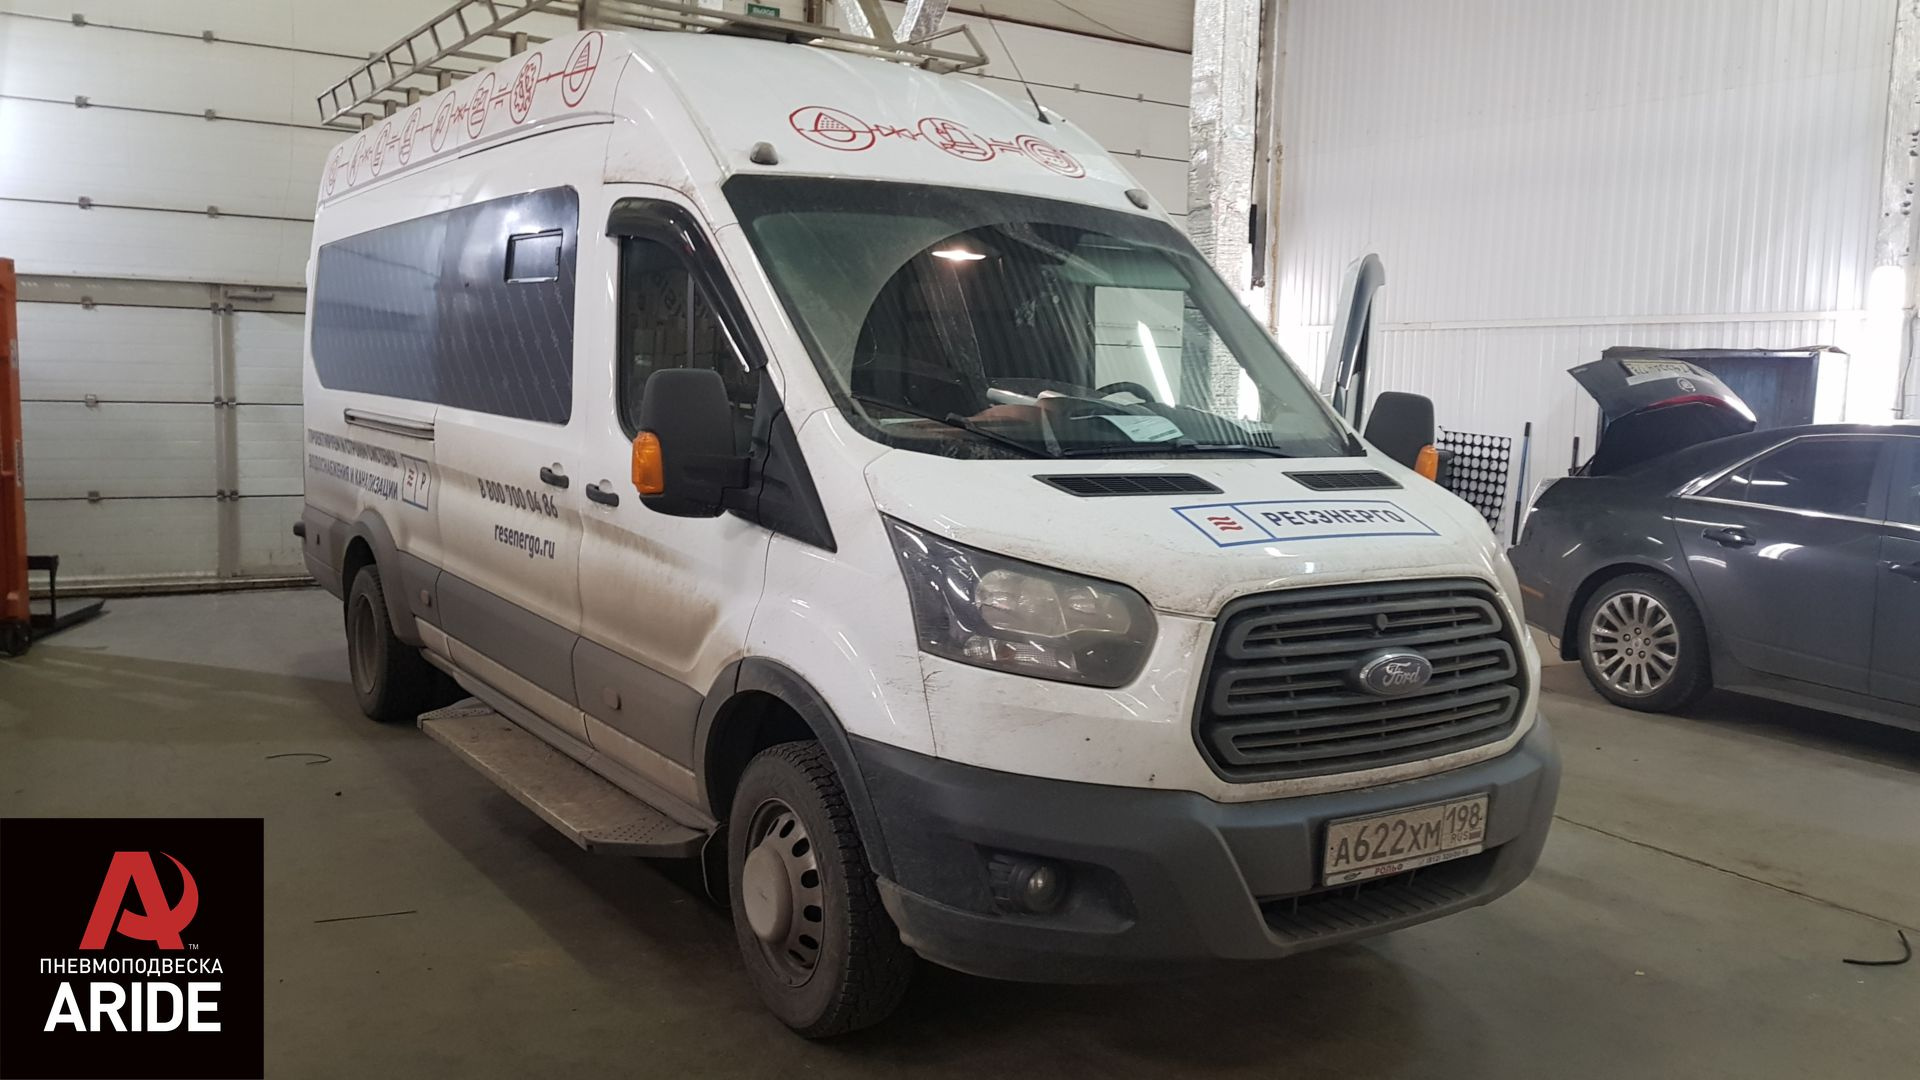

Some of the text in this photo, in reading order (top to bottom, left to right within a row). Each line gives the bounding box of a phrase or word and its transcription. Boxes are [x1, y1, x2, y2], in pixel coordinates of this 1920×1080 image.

[478, 478, 558, 519] 8 800 700 04 86
[1260, 508, 1406, 527] РЕСЭНЕРГО
[494, 524, 556, 559] resenergo.ru
[1382, 661, 1421, 687] Ford
[1446, 802, 1481, 834] 198
[1451, 830, 1469, 843] RUS
